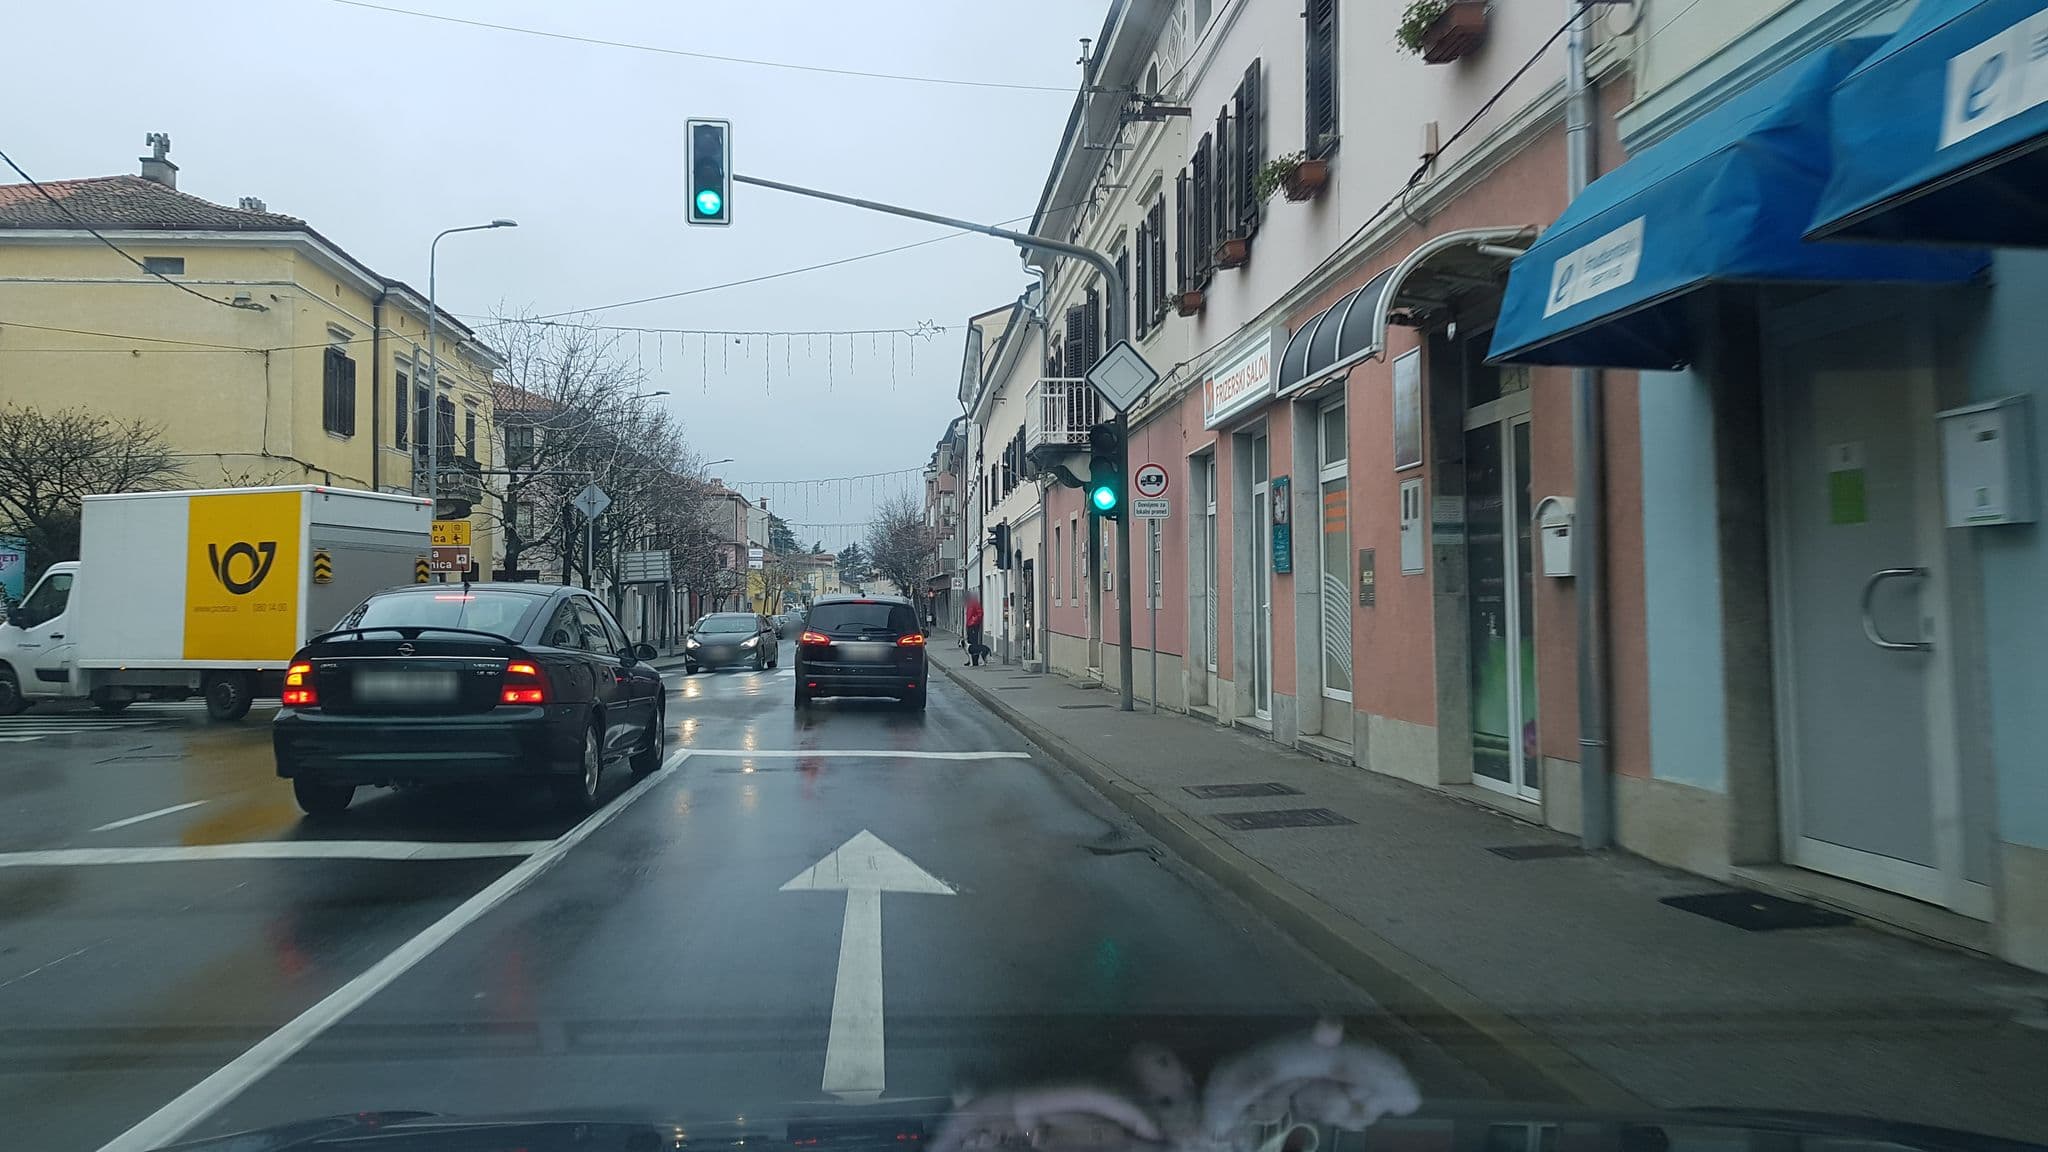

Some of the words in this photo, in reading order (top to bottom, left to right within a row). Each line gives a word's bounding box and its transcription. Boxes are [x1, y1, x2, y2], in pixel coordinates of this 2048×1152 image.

[1215, 368, 1246, 407] FRIZERSKI
[1246, 351, 1269, 388] SALON
[432, 524, 445, 532] ev
[433, 535, 446, 543] ca
[432, 550, 439, 558] a
[432, 560, 452, 569] nica
